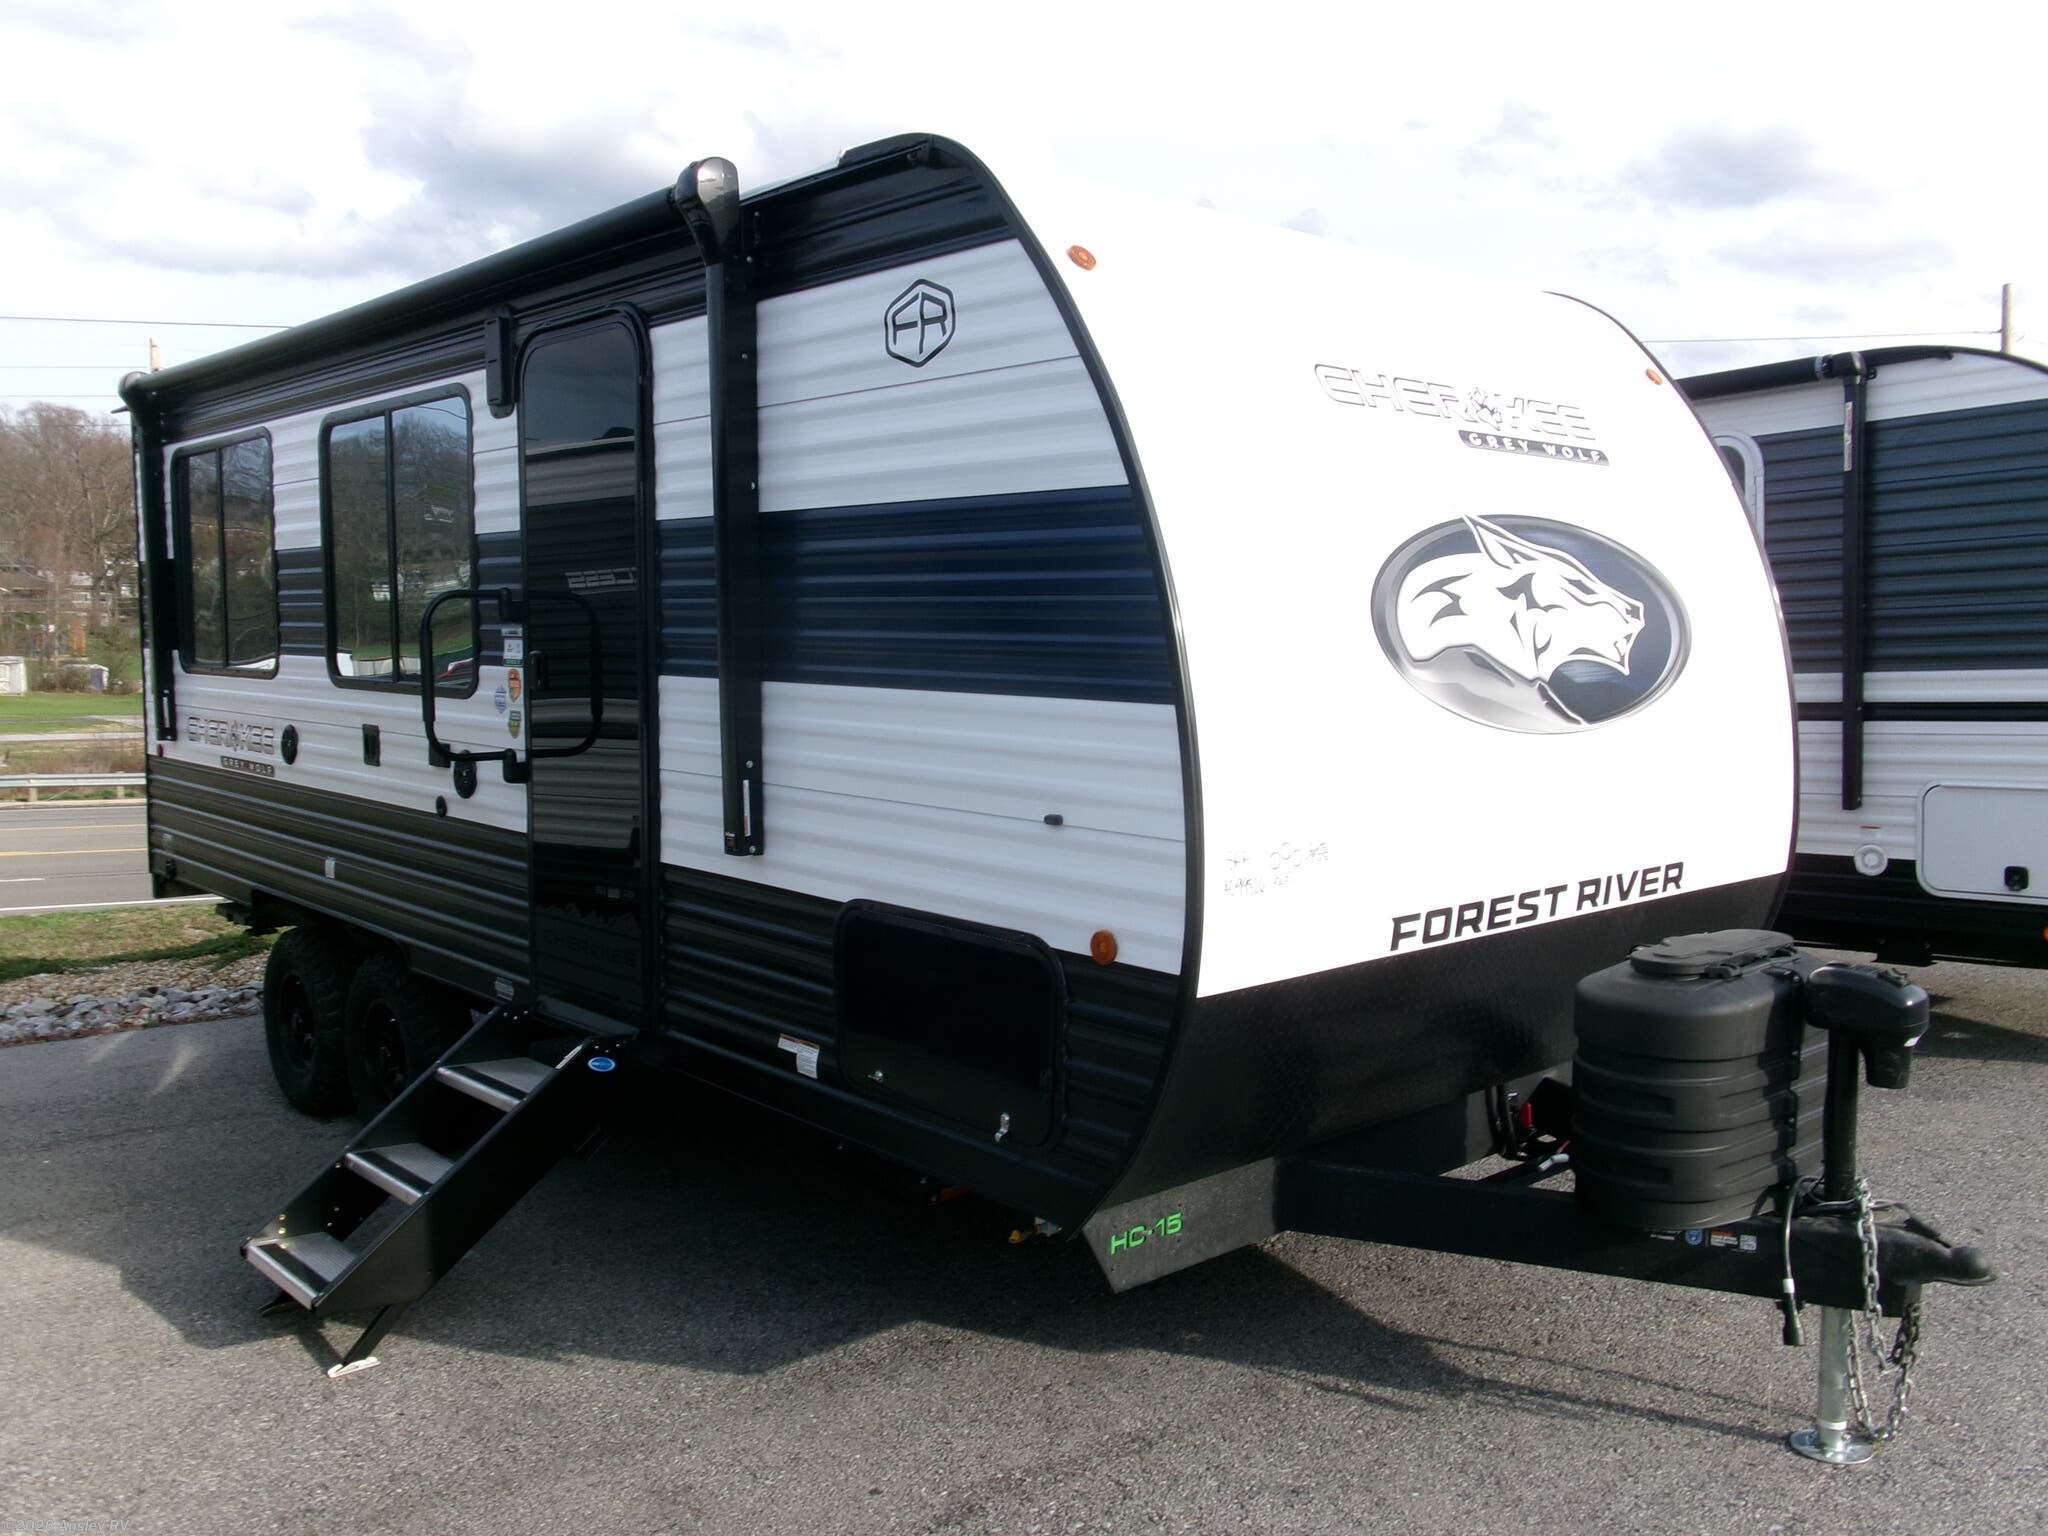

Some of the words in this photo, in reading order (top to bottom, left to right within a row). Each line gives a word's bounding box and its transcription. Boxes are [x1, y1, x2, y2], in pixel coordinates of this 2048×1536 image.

[1467, 431, 1530, 453] GREY
[1542, 441, 1602, 464] WOLF
[1389, 884, 1569, 952] FOREST
[1575, 861, 1685, 912] RIVER
